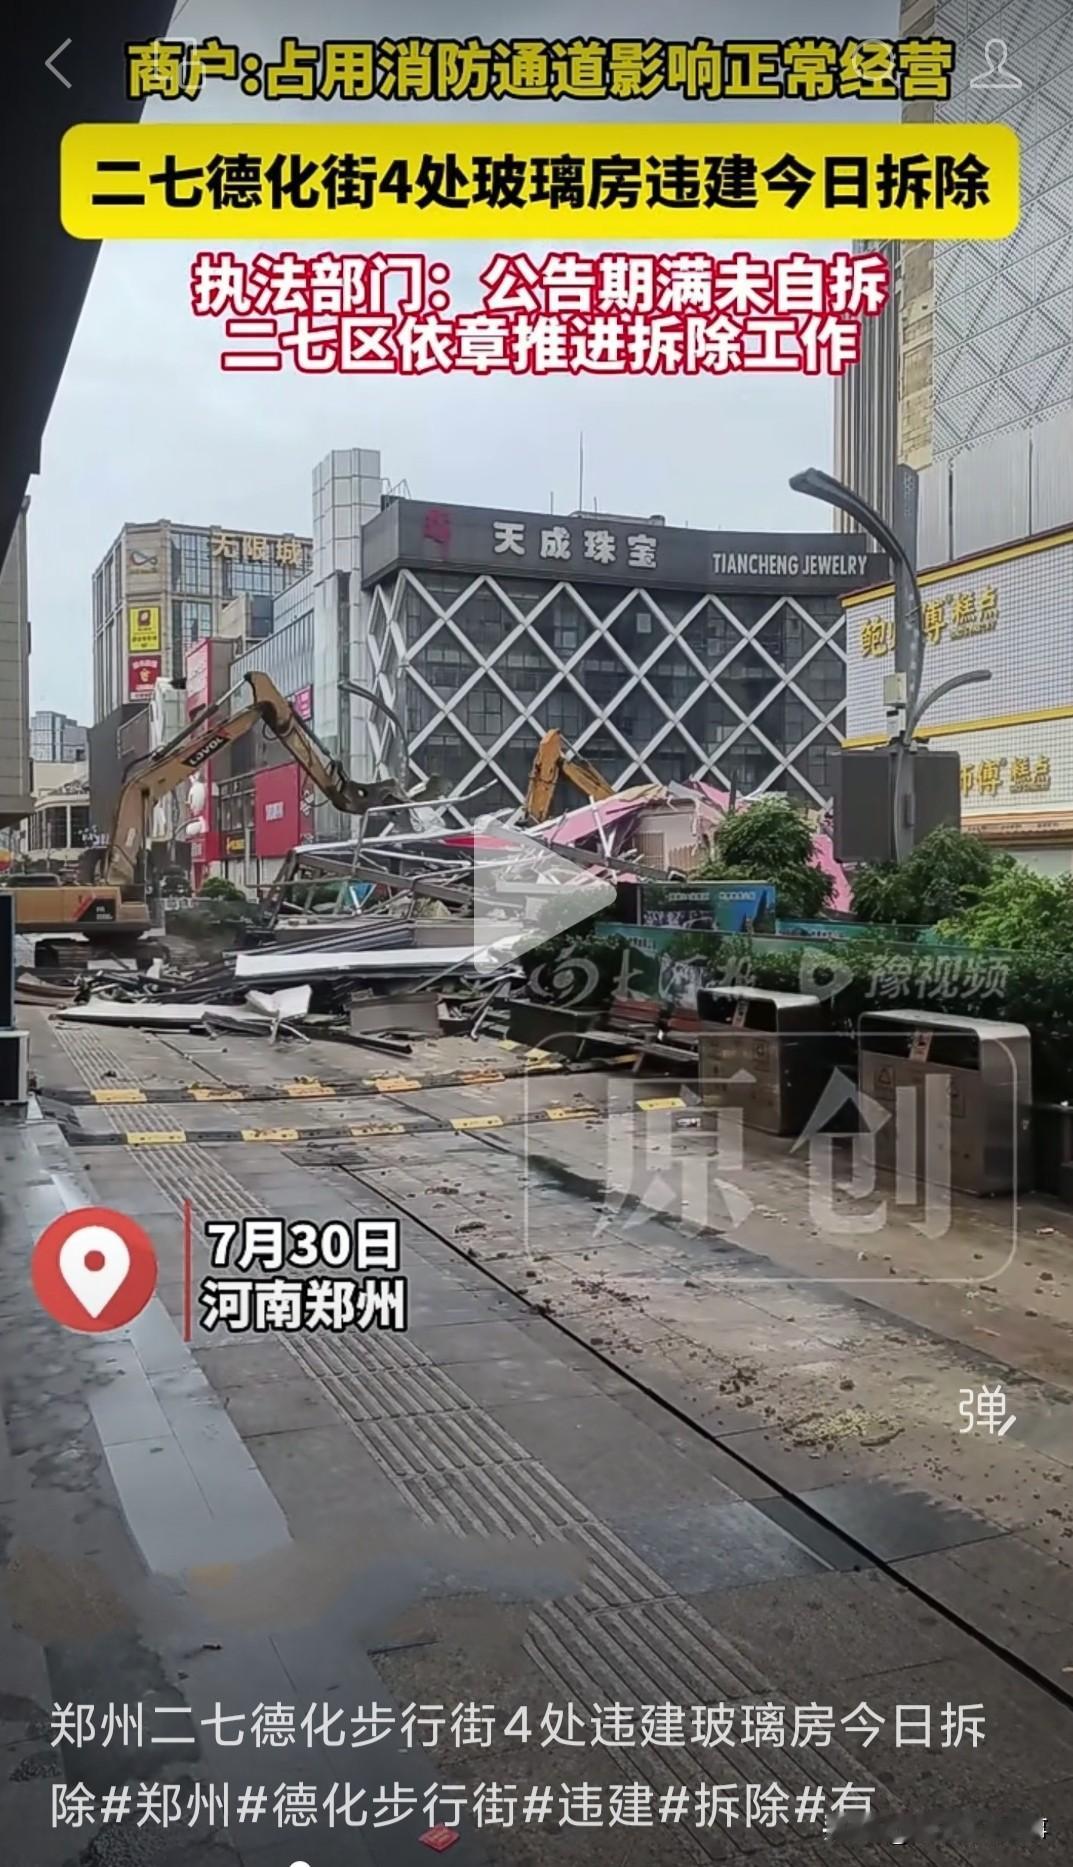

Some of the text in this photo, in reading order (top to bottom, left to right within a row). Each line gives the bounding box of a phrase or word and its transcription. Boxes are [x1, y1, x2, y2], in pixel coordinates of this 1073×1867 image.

[210, 534, 304, 567] 无限城
[492, 520, 658, 569] 天成珠宝
[711, 552, 868, 576] TIANCHENG JEWELRY
